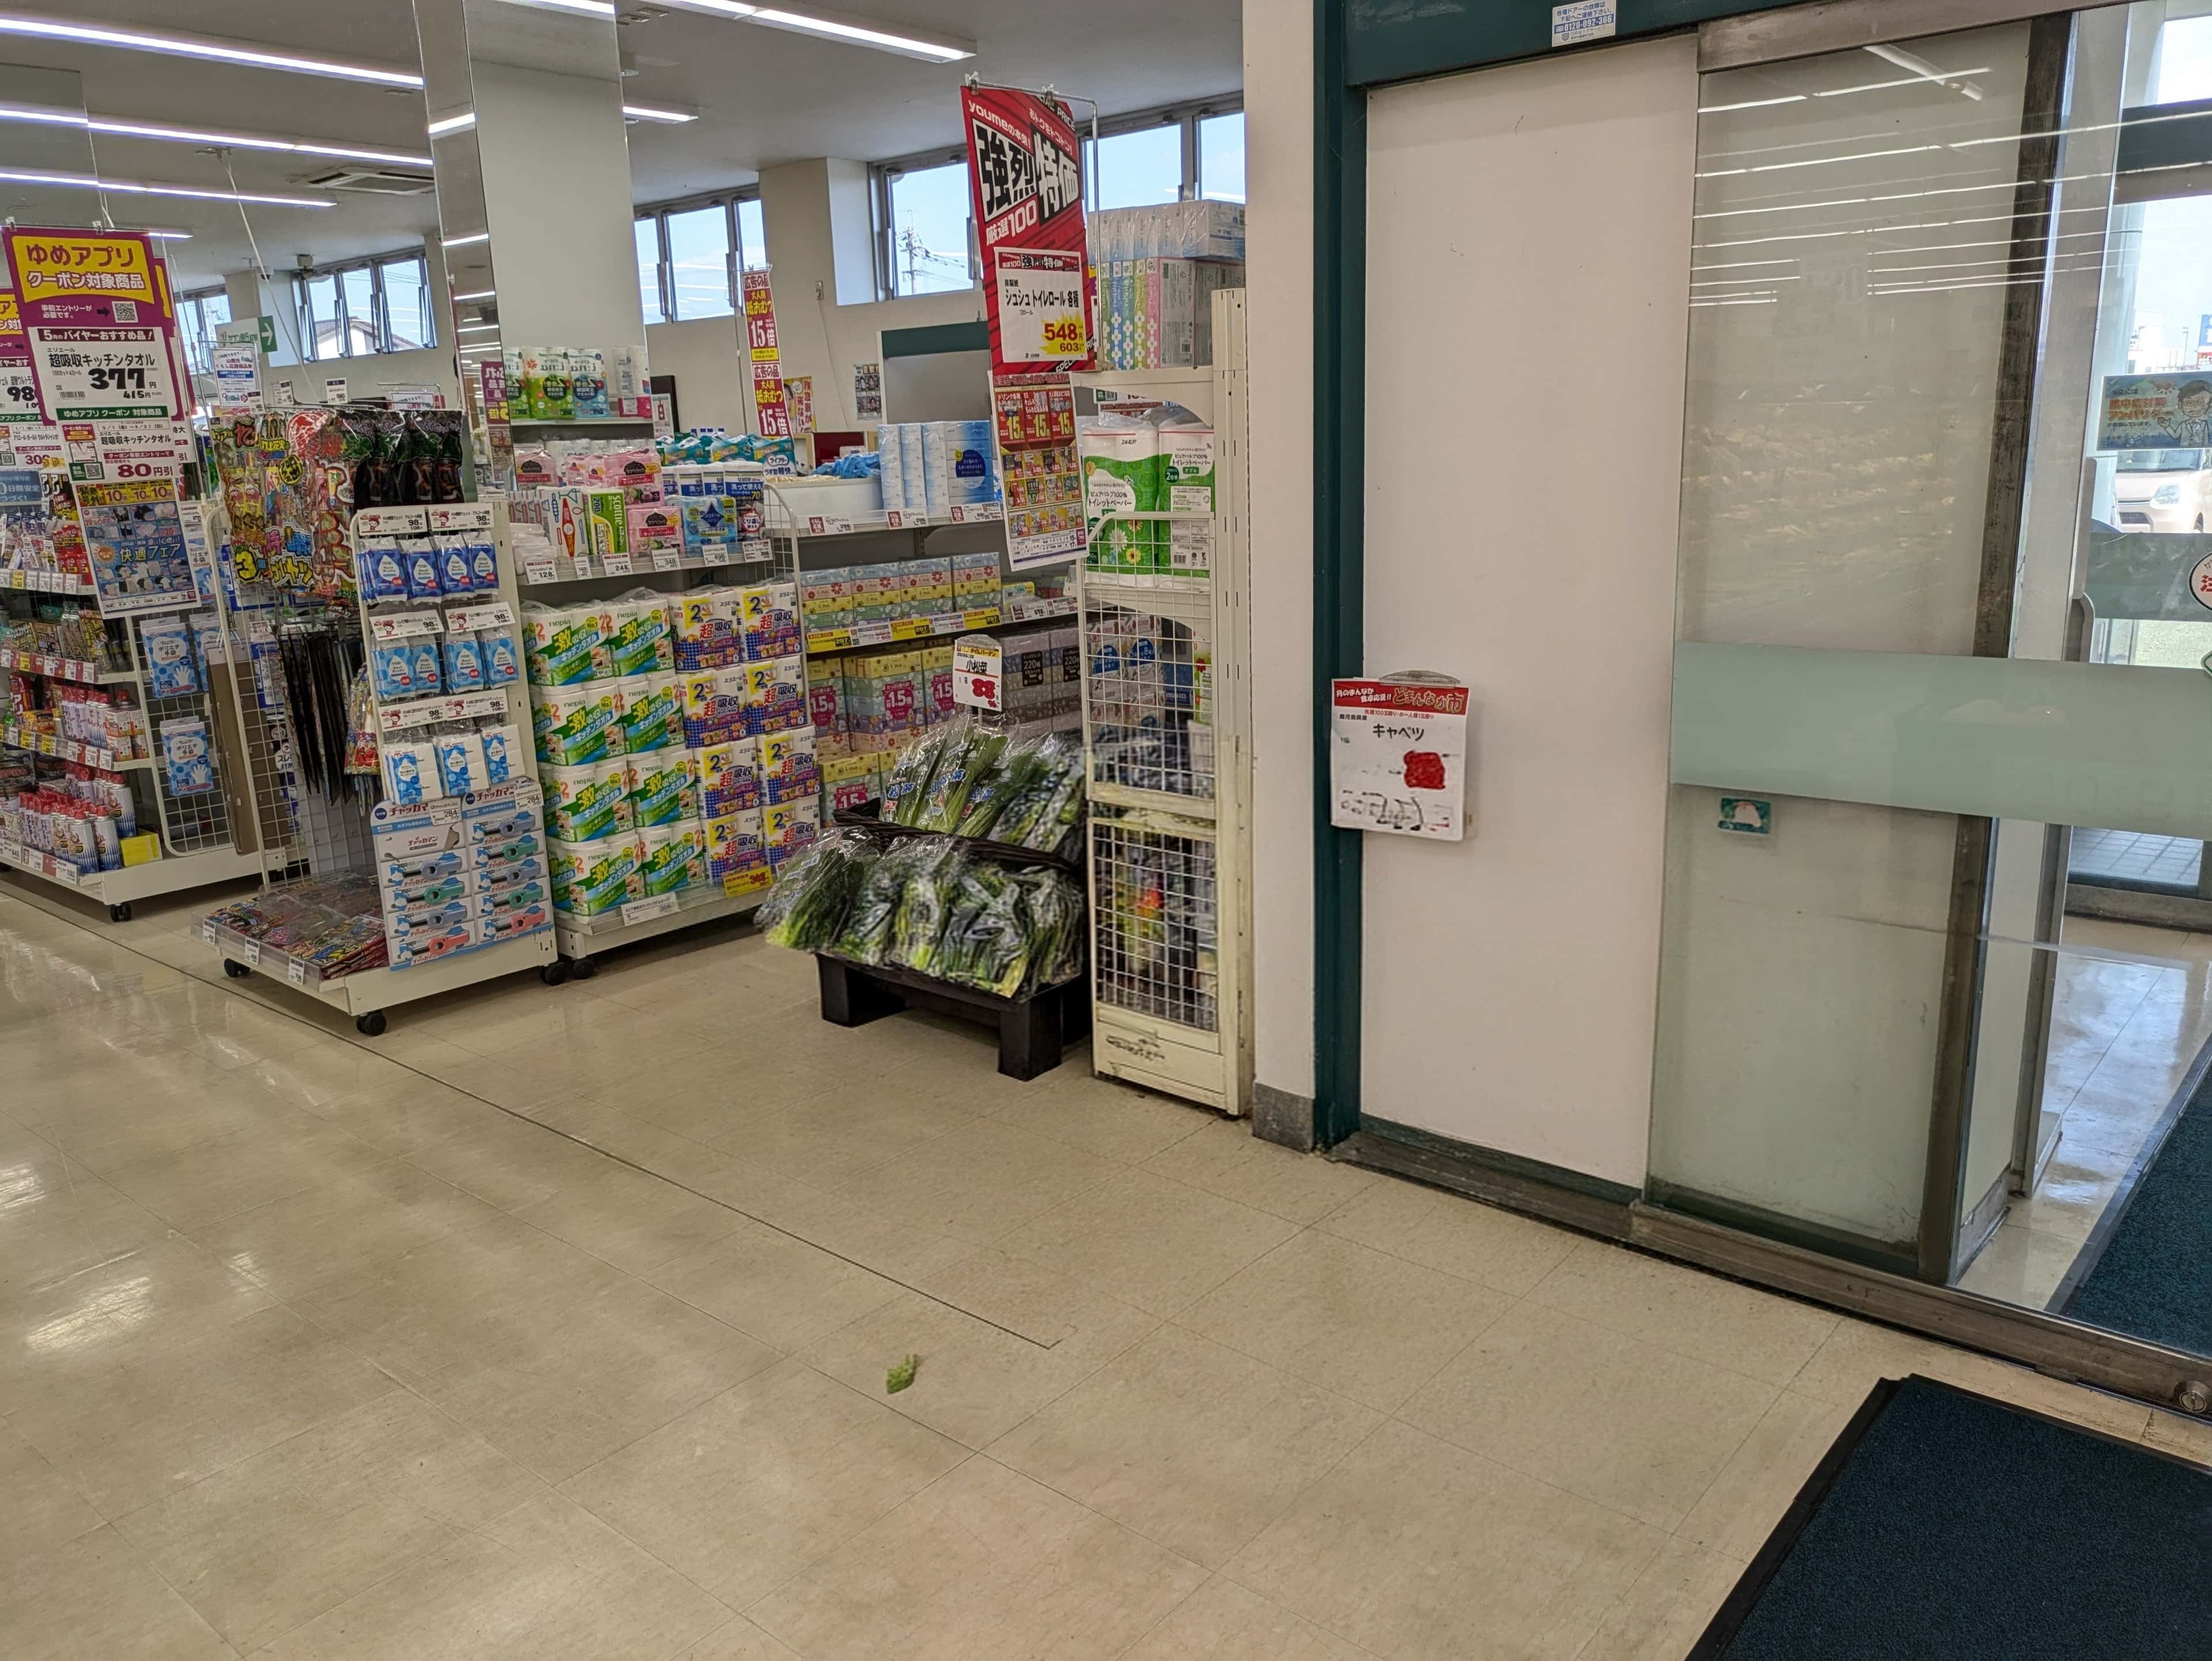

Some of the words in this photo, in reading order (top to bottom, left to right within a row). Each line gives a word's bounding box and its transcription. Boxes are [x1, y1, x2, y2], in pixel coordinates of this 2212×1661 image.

[1565, 15, 1612, 31] 0120-092-366
[986, 199, 1037, 246] 厳選100
[26, 244, 134, 267] ゆめアプリ
[27, 271, 146, 290] クーポン対象商品
[1044, 323, 1078, 341] 548
[1059, 343, 1079, 352] 603
[48, 353, 156, 368] 超吸収キッチンタオル
[88, 368, 146, 390] 377
[7, 386, 37, 402] 98
[63, 410, 99, 418] ゆめアプリ
[118, 463, 152, 478] 80
[120, 543, 181, 563] 快適フェア
[549, 618, 571, 627] nepia
[617, 611, 638, 619] nepia
[560, 631, 598, 661] キッチンタオル
[627, 625, 662, 652] キッチンタオル
[965, 659, 988, 675] 小松菜
[628, 689, 649, 697] nepia
[1392, 686, 1465, 713] どまんなか市
[564, 699, 586, 708] nepia
[638, 702, 672, 730] キッチンタオル
[575, 713, 612, 742] キッチンタオル
[1373, 723, 1425, 741] キャベツ
[642, 765, 662, 773] nepia
[573, 777, 595, 786] nepia
[651, 777, 685, 805] キッチンタオル
[527, 796, 540, 804] 284
[584, 789, 620, 818] キッチンタオル
[389, 802, 429, 816] チャッカマ
[444, 809, 457, 817] 284
[650, 836, 671, 845] nepia
[588, 852, 609, 861] nepia
[660, 847, 693, 876] キッチンタオル
[599, 862, 633, 892] キッチンタオル
